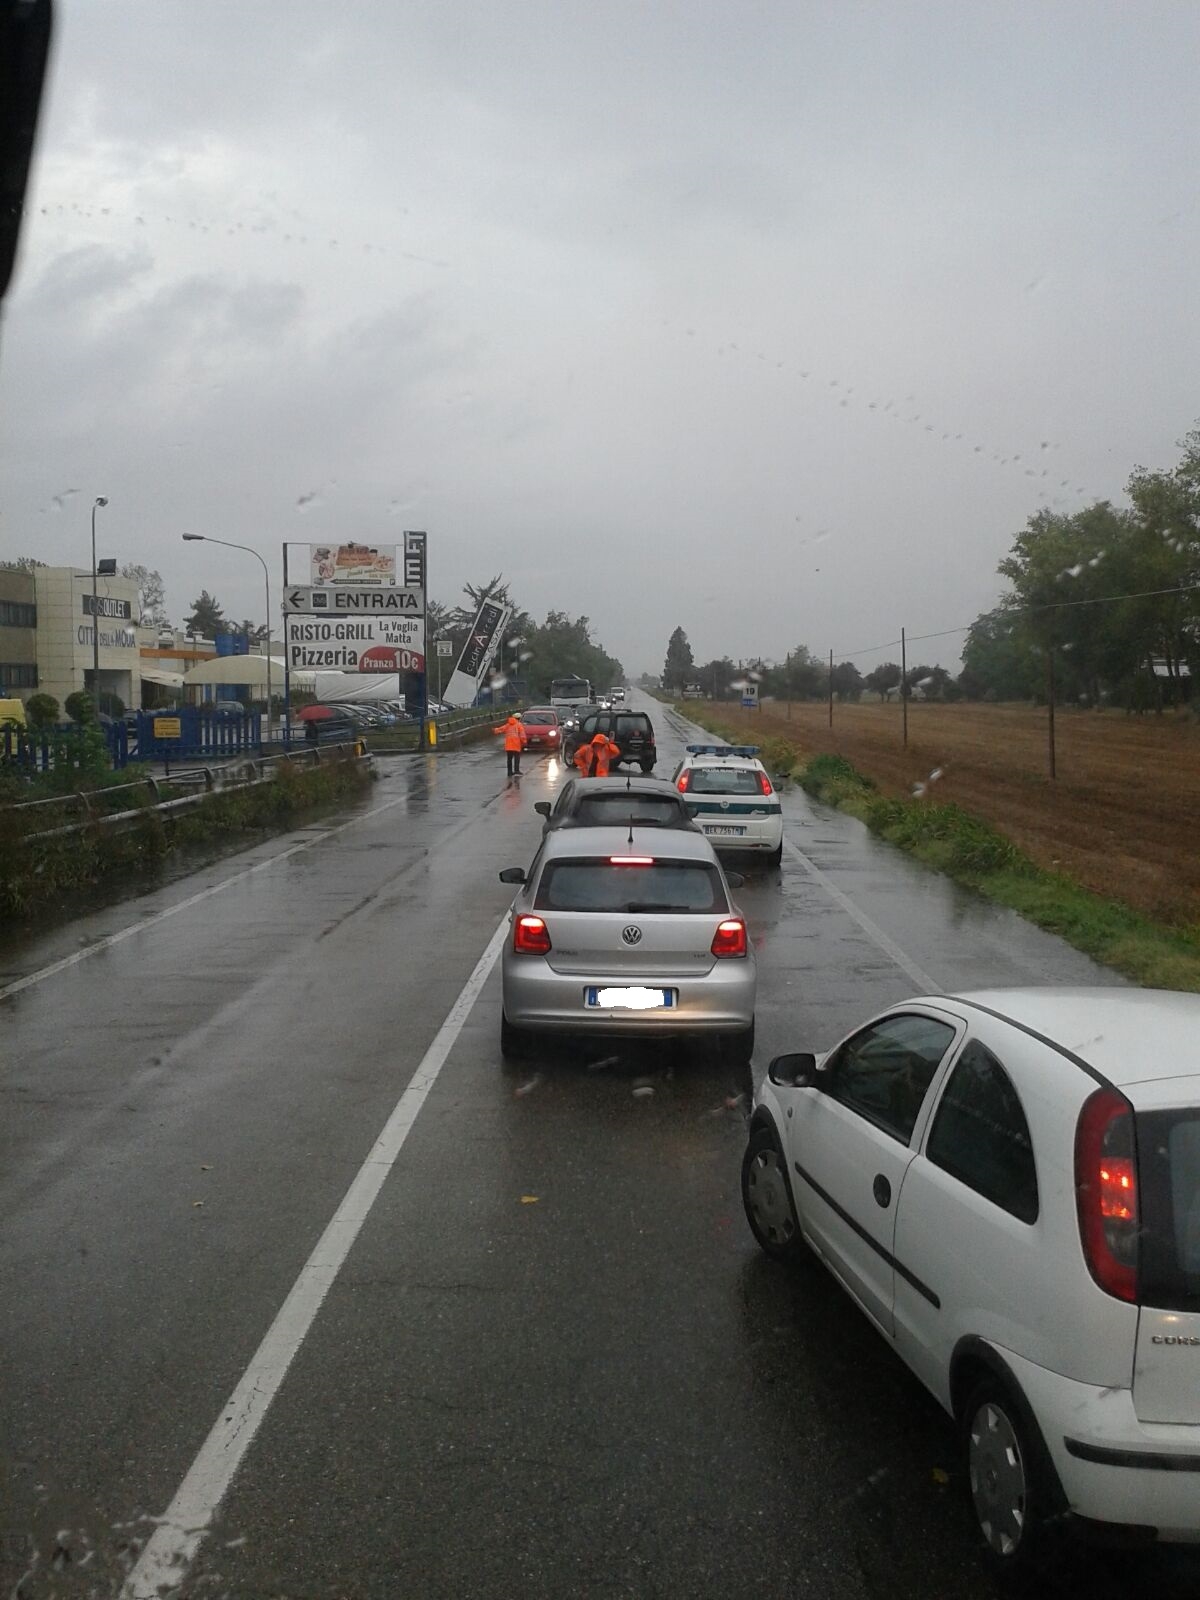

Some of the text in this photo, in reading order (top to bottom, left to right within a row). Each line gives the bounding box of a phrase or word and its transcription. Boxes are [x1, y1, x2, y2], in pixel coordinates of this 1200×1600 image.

[335, 593, 418, 608] ENTRATA
[290, 624, 375, 640] RISTO-GRILL
[379, 621, 418, 633] La Voglia
[386, 633, 412, 644] Matta
[291, 646, 358, 667] Pizzeria
[363, 651, 418, 669] Pranzo 10€
